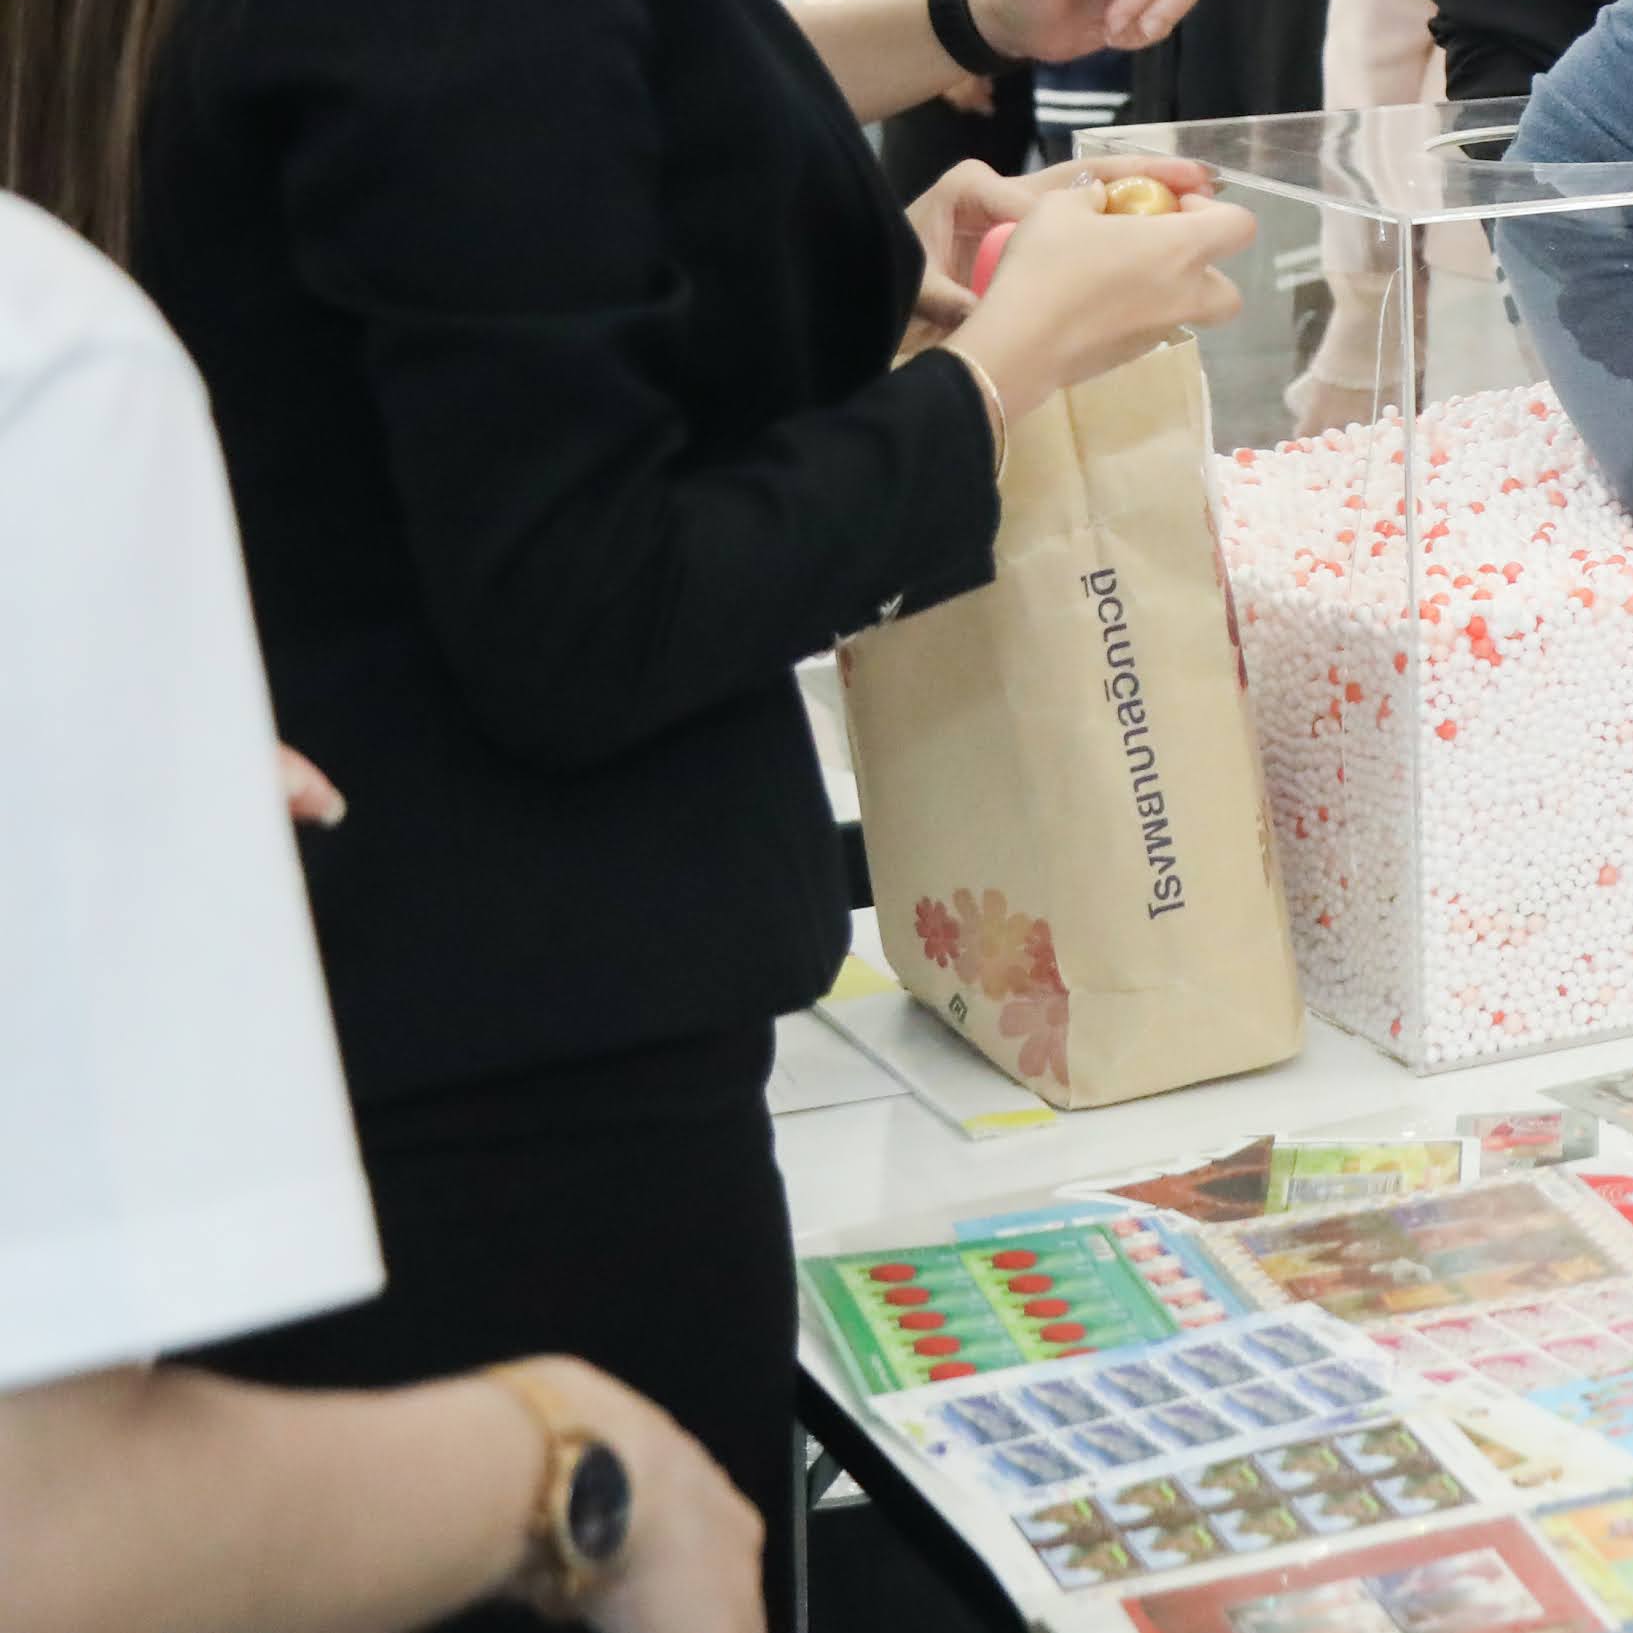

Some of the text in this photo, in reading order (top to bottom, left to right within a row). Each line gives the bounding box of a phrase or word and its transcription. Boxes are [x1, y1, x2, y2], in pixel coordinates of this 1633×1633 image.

[1080, 567, 1187, 922] โรงพยาบาลวิภาวดี
